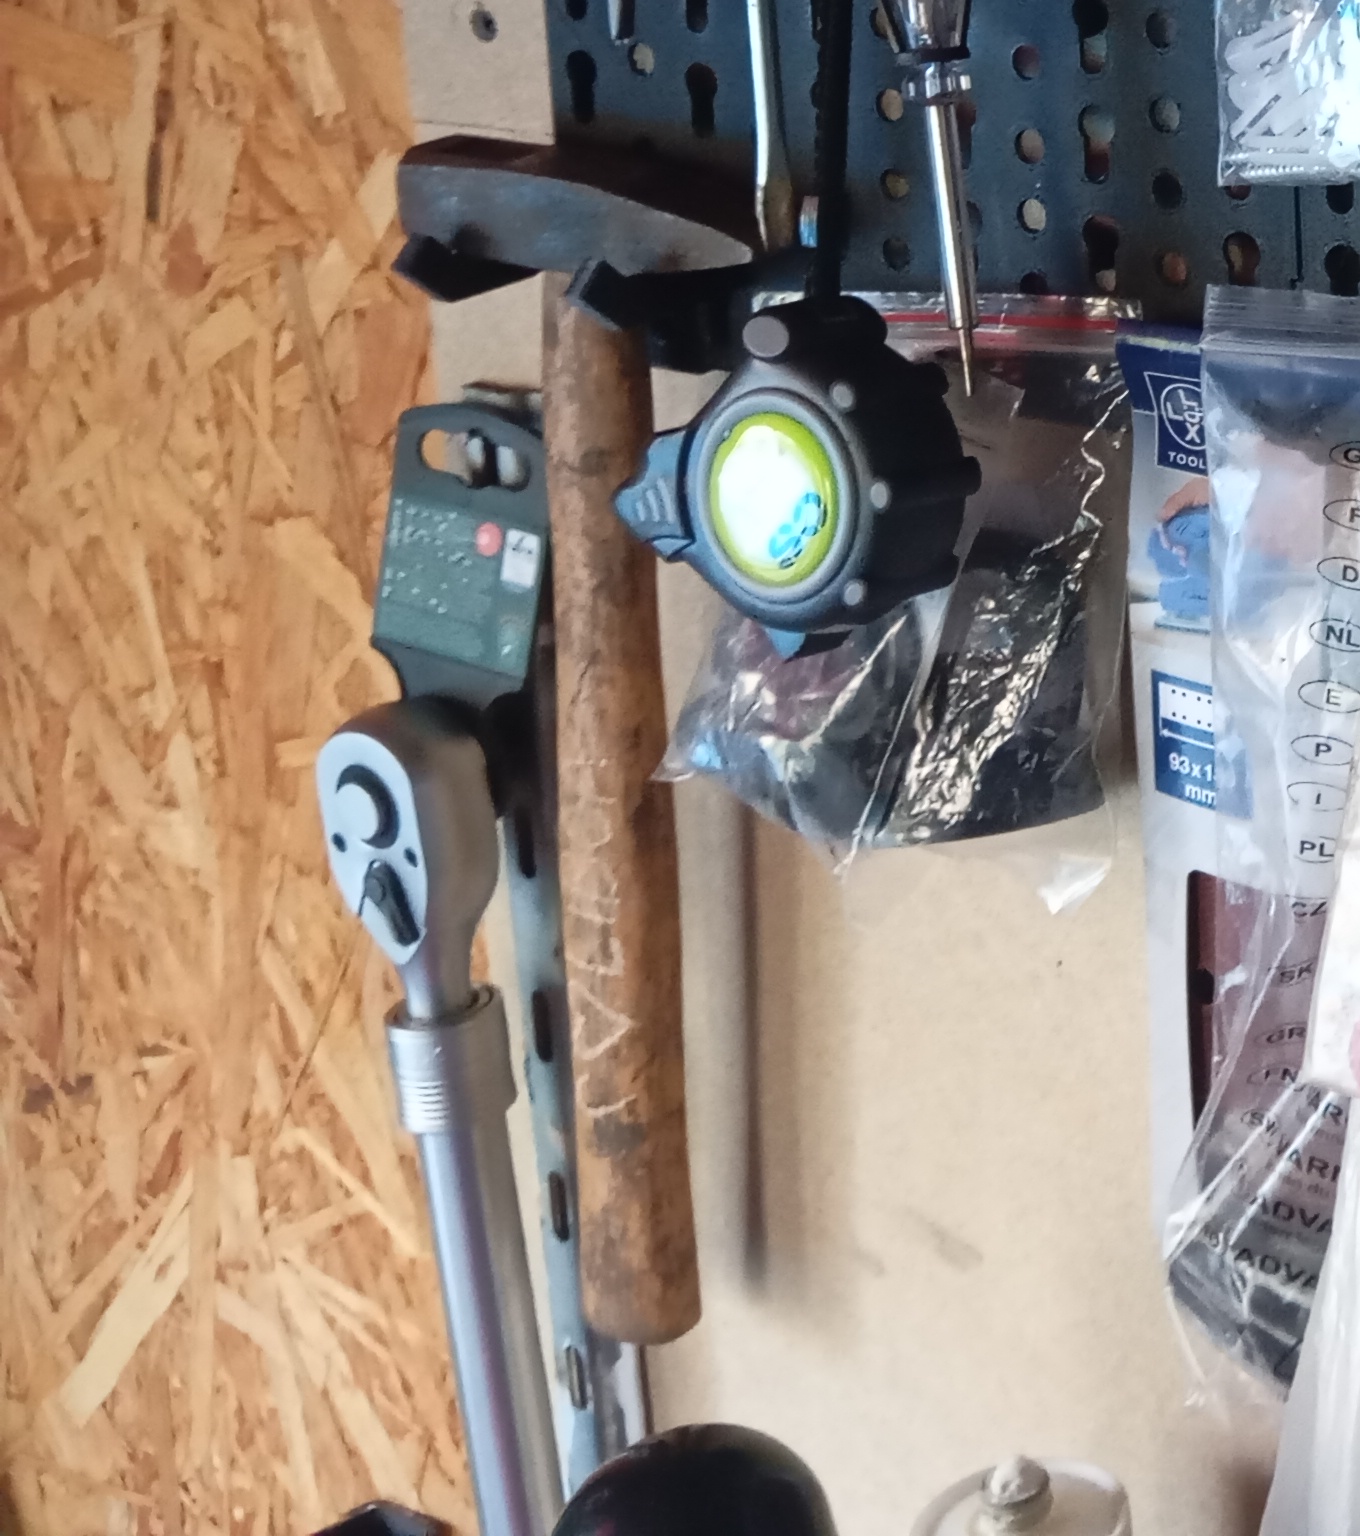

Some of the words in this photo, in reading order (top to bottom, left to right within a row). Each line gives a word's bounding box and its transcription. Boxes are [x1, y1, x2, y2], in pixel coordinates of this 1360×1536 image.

[1168, 451, 1207, 470] TOOL
[1325, 625, 1360, 648] NL
[1169, 752, 1214, 782] 93x1
[1299, 840, 1335, 858] PL
